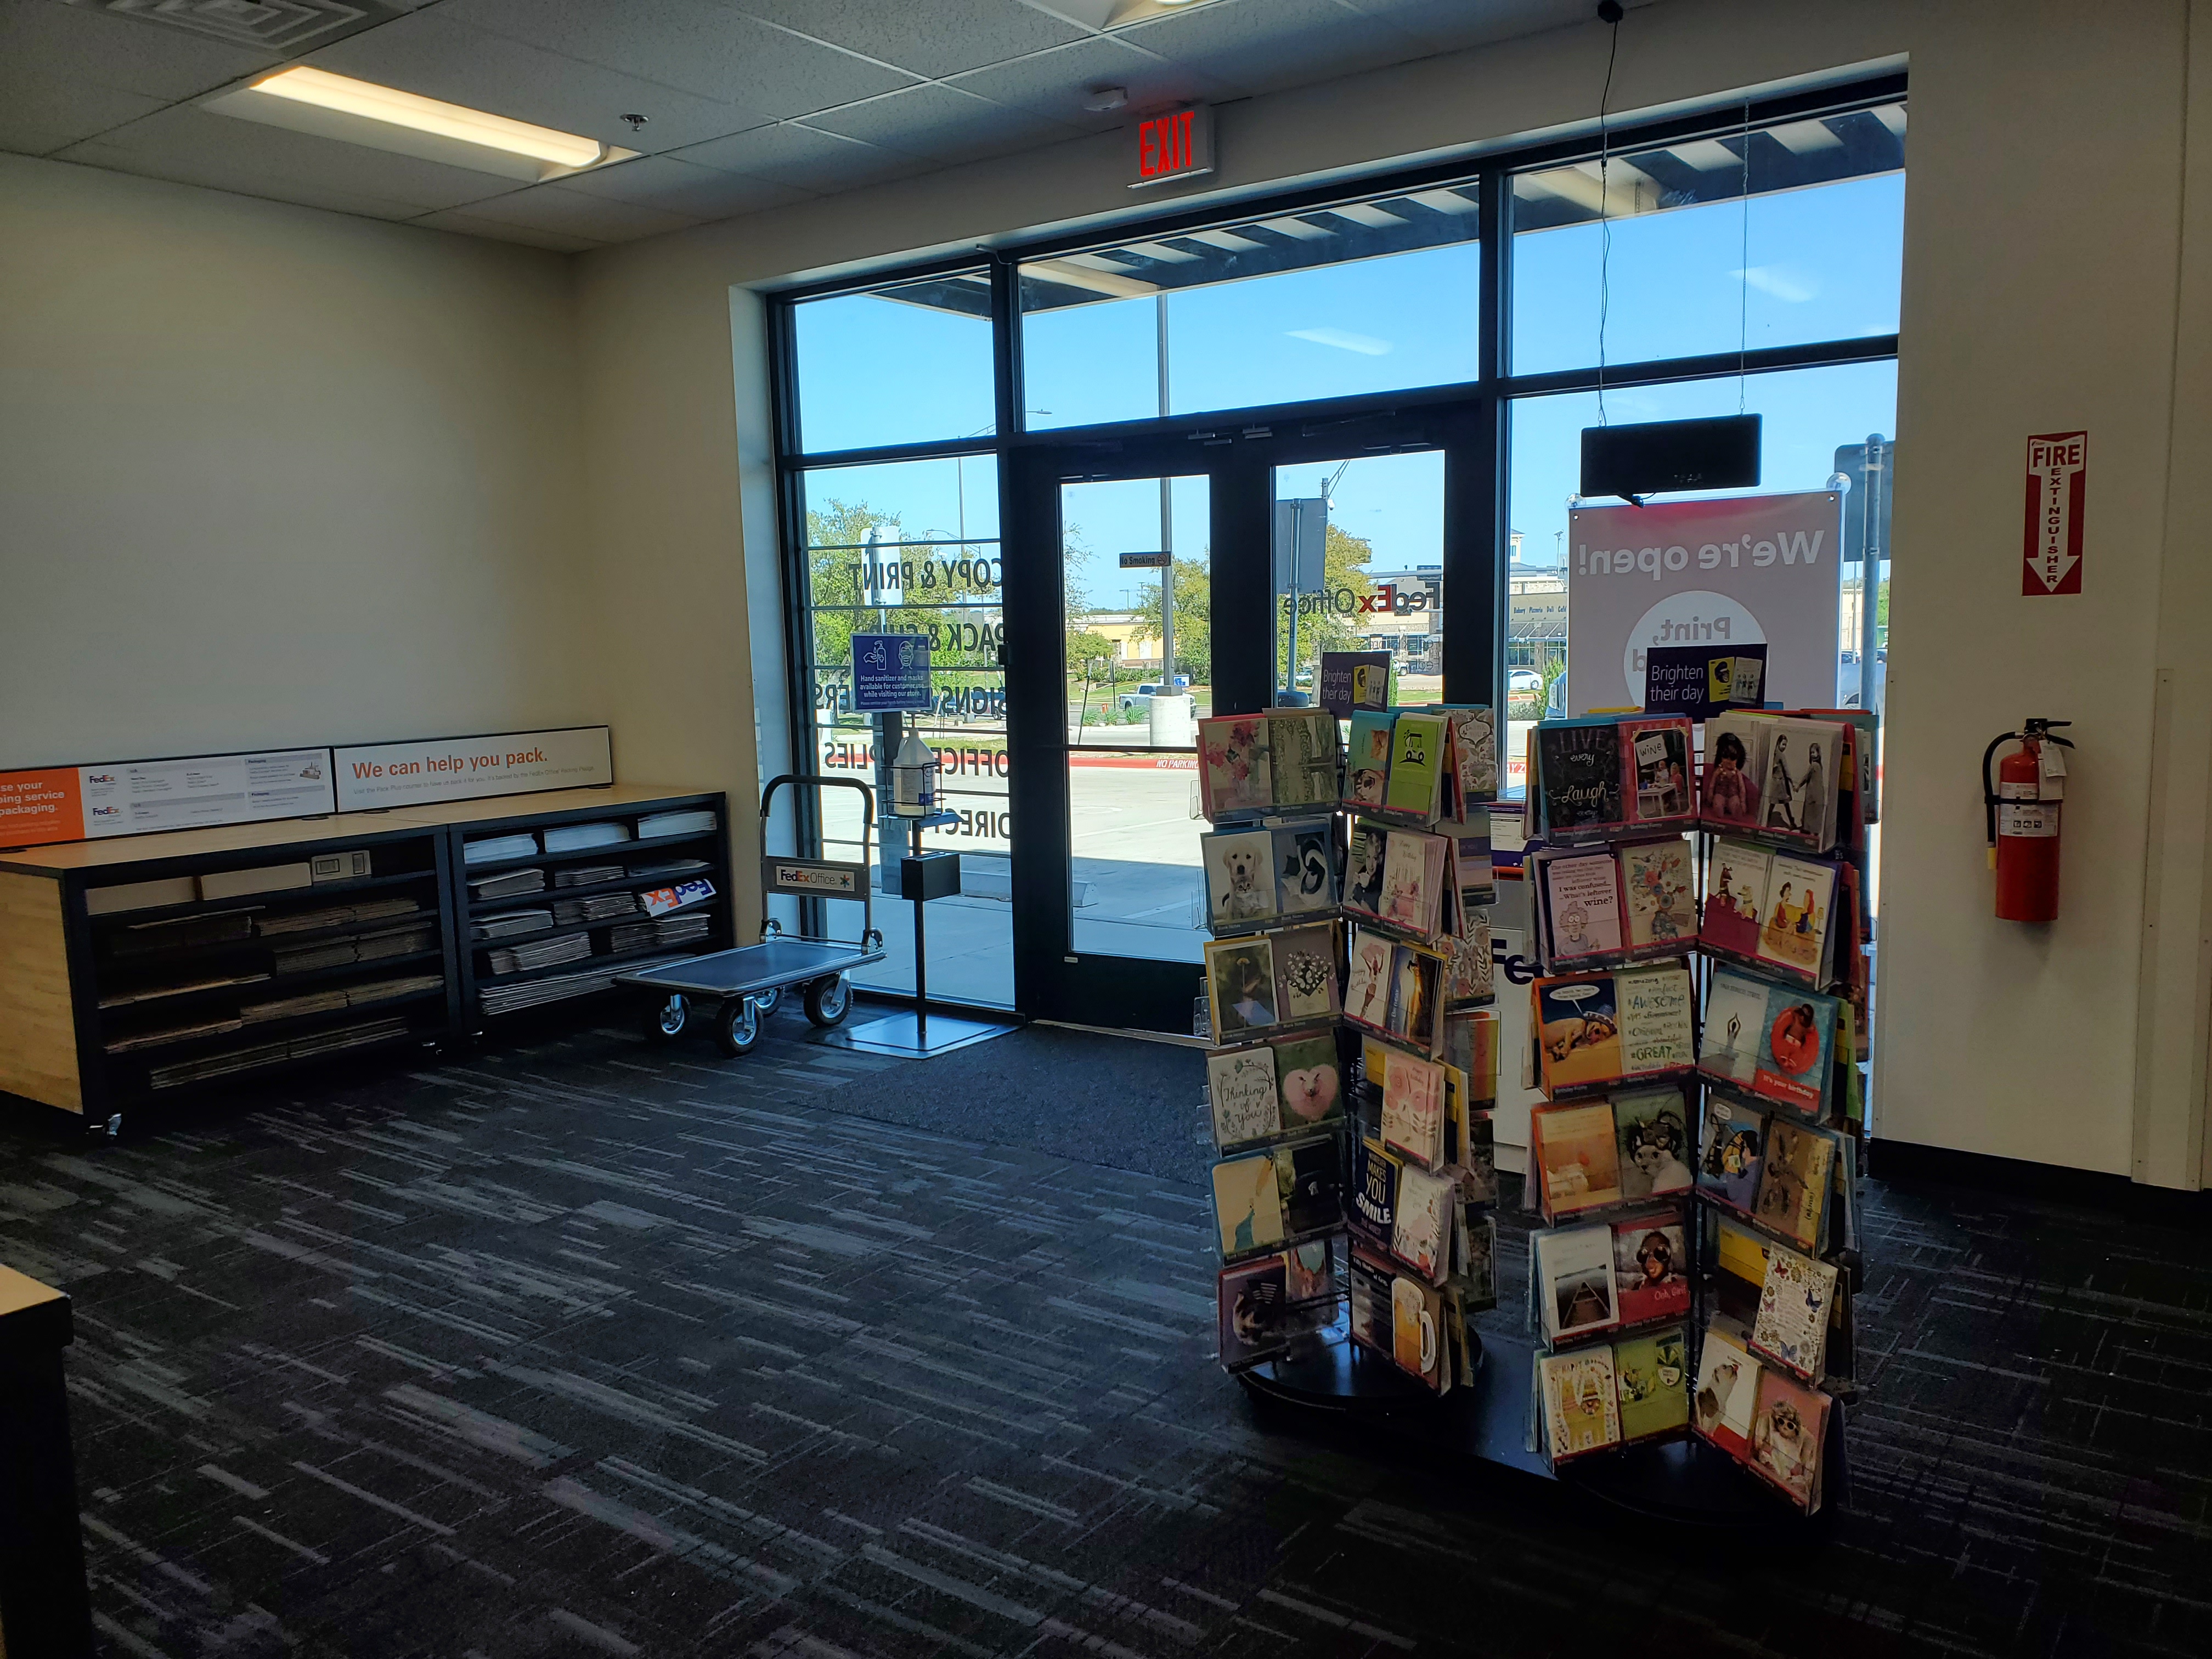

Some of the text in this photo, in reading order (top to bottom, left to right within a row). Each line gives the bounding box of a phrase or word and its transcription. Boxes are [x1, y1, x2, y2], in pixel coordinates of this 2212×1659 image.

[1139, 111, 1194, 177] EXIT
[2033, 443, 2080, 467] FIRE
[2046, 467, 2062, 583] EXTINGUISHER
[1129, 556, 1155, 566] Smoking
[1323, 669, 1351, 686] Brighten
[1651, 664, 1703, 684] Brighten
[878, 690, 897, 698] visiting
[1323, 686, 1351, 704] their day
[1650, 684, 1705, 704] their day
[1559, 728, 1609, 754] LIVE
[352, 747, 548, 779] We can help you pack.
[1156, 759, 1168, 768] NO
[1570, 753, 1596, 767] every
[17, 782, 43, 792] your
[89, 774, 115, 784] FedEx
[25, 791, 65, 801] service
[1561, 781, 1609, 808] Laugh
[93, 806, 120, 816] FedEx
[781, 870, 836, 885] FedEx Office
[646, 879, 713, 909] FedEx
[1584, 896, 1613, 907] wine?
[1774, 1079, 1787, 1088] your
[1223, 1084, 1267, 1102] Thinking
[1240, 1098, 1250, 1113] of
[1367, 1158, 1386, 1184] MAKES
[1366, 1172, 1386, 1205] YOU
[1356, 1192, 1392, 1224] SMILE
